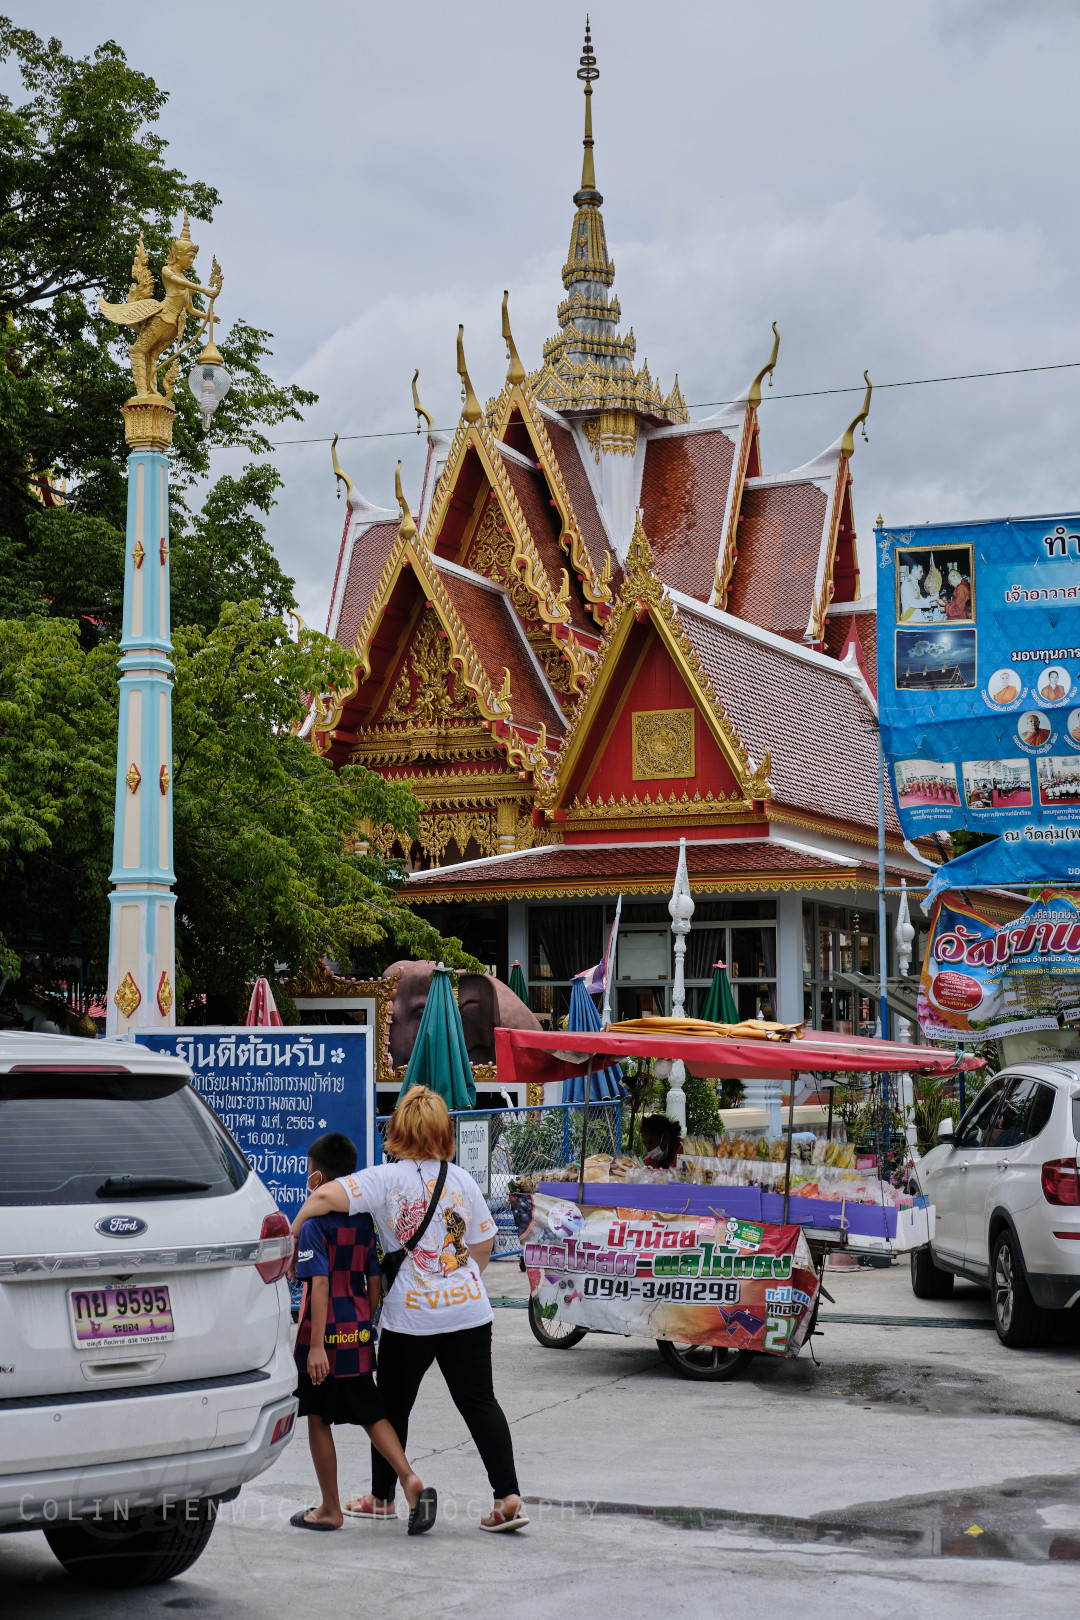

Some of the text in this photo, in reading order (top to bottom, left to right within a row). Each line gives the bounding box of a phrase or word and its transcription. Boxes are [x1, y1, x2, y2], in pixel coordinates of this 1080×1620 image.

[1005, 831, 1020, 841] ณ
[175, 1035, 325, 1067] ยินดีต้อนรับ
[261, 1115, 283, 1130] พ.ศ.
[286, 1116, 315, 1130] 2565
[242, 1149, 308, 1174] ัดบ้านดอ
[110, 1218, 137, 1232] Ford
[607, 1220, 697, 1249] ป้าน้อย
[405, 1281, 482, 1310] EVISU
[583, 1277, 738, 1303] 094-3481298
[75, 1288, 167, 1319] กย 9595
[113, 1323, 139, 1333] ระยอง
[324, 1329, 359, 1344] unicef
